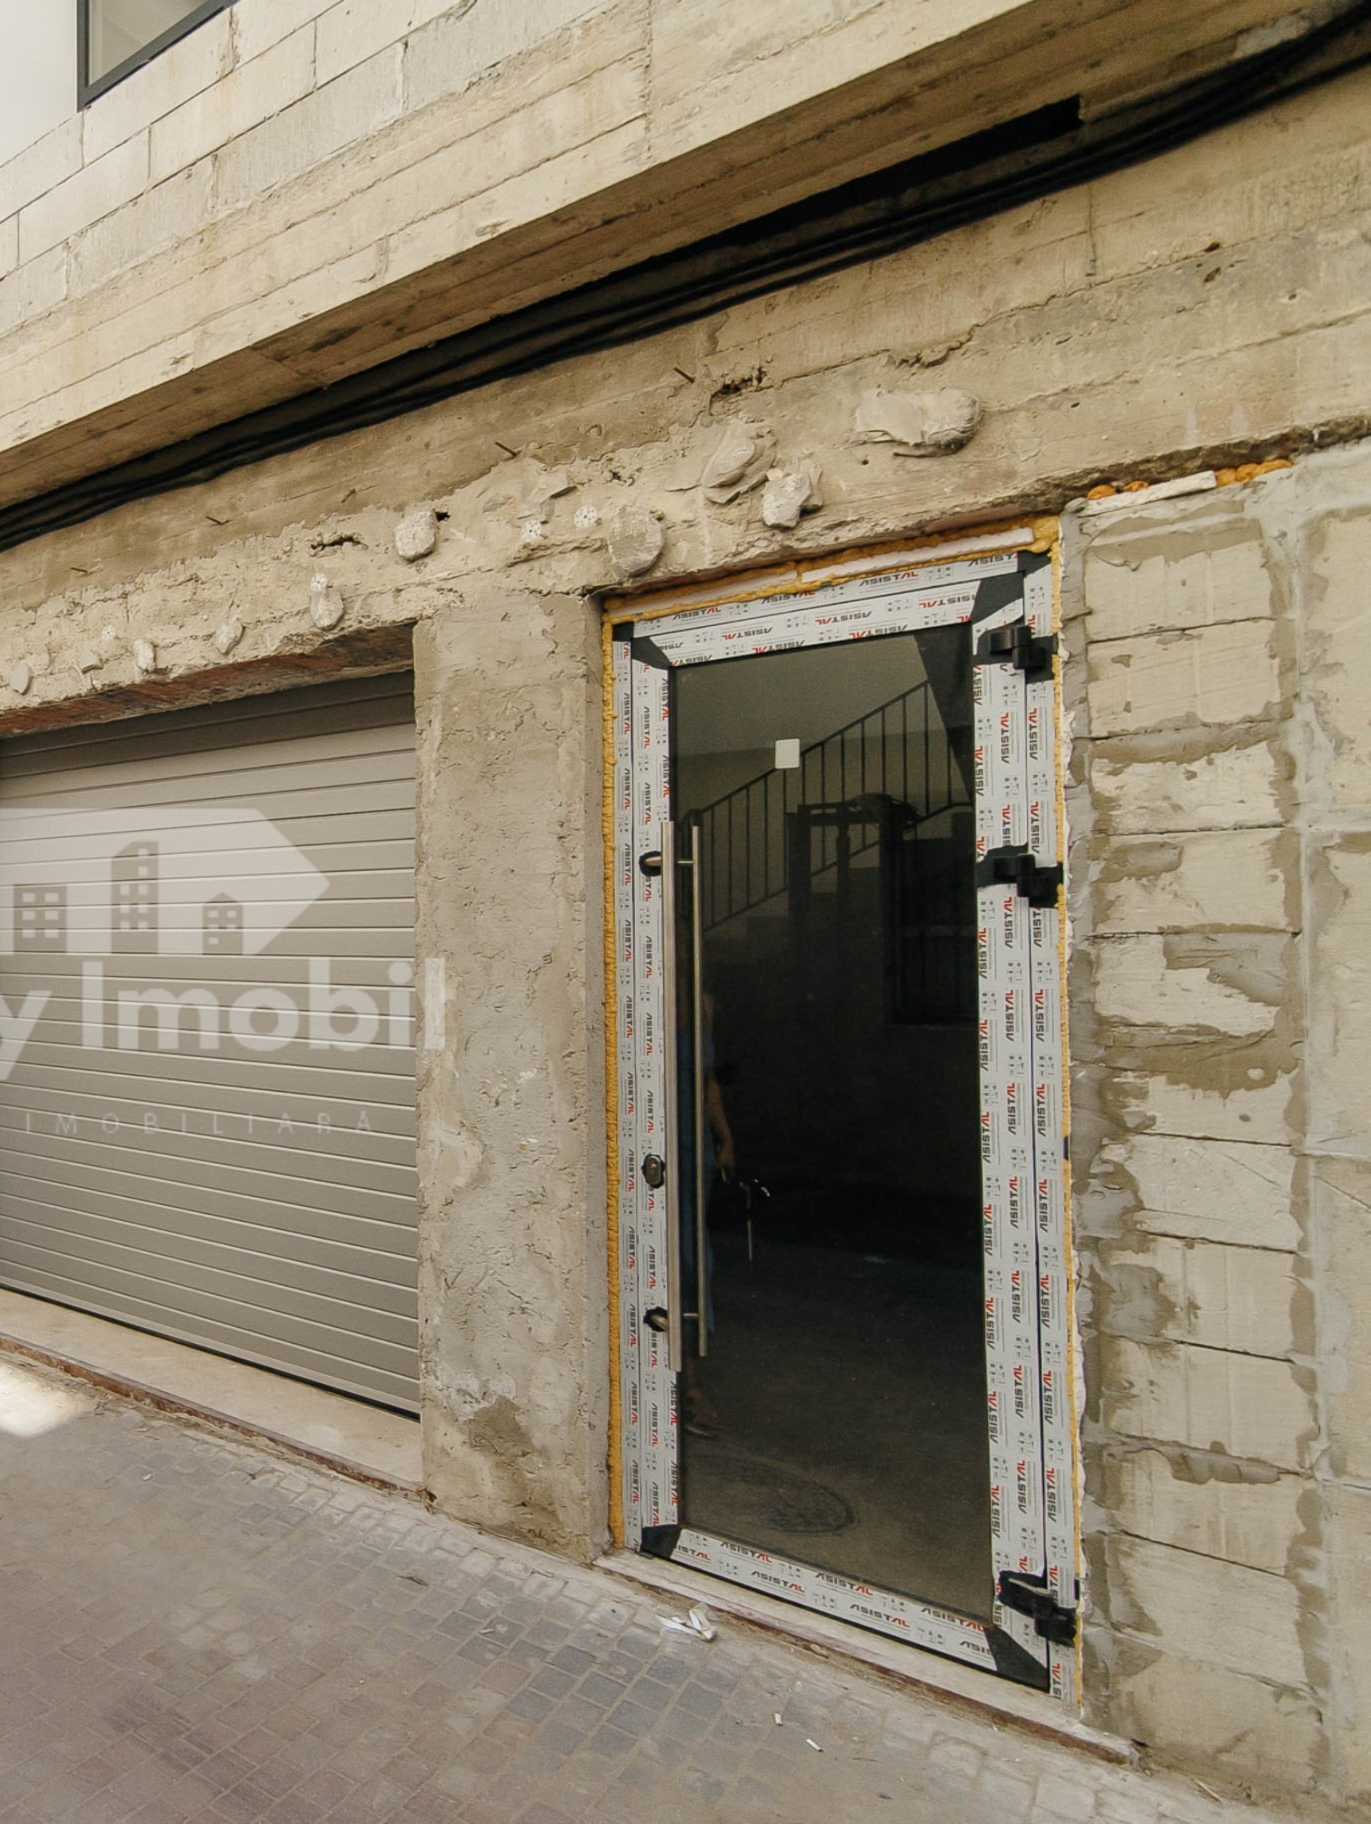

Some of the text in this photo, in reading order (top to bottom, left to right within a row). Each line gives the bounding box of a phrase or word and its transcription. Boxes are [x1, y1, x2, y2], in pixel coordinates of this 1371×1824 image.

[859, 571, 919, 586] ASISTAL
[968, 552, 1018, 567] ASIST
[672, 606, 722, 620] ASISTAL
[815, 610, 872, 625] ASISTAL
[919, 594, 976, 608] SISTAL
[721, 626, 774, 641] ASISTAL
[752, 640, 806, 654] ASISTAL
[849, 624, 908, 640] ASISTAL
[1000, 712, 1010, 764] ASISTAL
[1028, 708, 1038, 760] ASISTAL
[974, 745, 984, 796] ASISTAL
[1002, 804, 1012, 846] SISTAL
[1030, 801, 1040, 854] ASISTAL
[1004, 896, 1014, 949] ASISTAL
[978, 927, 988, 980] ASISTAL
[1005, 989, 1014, 1042] ASISTAL
[1035, 988, 1044, 1042] ASISTAL
[980, 1018, 989, 1071] ASISTAL
[1007, 1082, 1017, 1135] ASISTAL
[1036, 1083, 1046, 1137] ASISTAL
[982, 1111, 991, 1164] ASISTAL
[1010, 1176, 1020, 1229] ASISTAL
[1038, 1178, 1048, 1232] ASISTAL
[983, 1203, 993, 1256] ASISTAL
[986, 1296, 996, 1350] ASISTAL
[1012, 1270, 1021, 1324] ASISTAL
[1040, 1274, 1050, 1328] ASISTAL
[988, 1390, 998, 1444] ASISTAL
[1014, 1364, 1024, 1419] ASISTAL
[1043, 1370, 1054, 1425] ASISTAL
[991, 1484, 1001, 1538] ASISTAL
[1016, 1460, 1026, 1514] ASISTAL
[1046, 1466, 1056, 1523] ASISTAL
[678, 1545, 711, 1560] ISTAL
[720, 1541, 773, 1563] ASISTAL
[751, 1570, 806, 1593] ASISTAL
[815, 1572, 874, 1596] ASISTAL
[850, 1603, 910, 1628] ASISTAL
